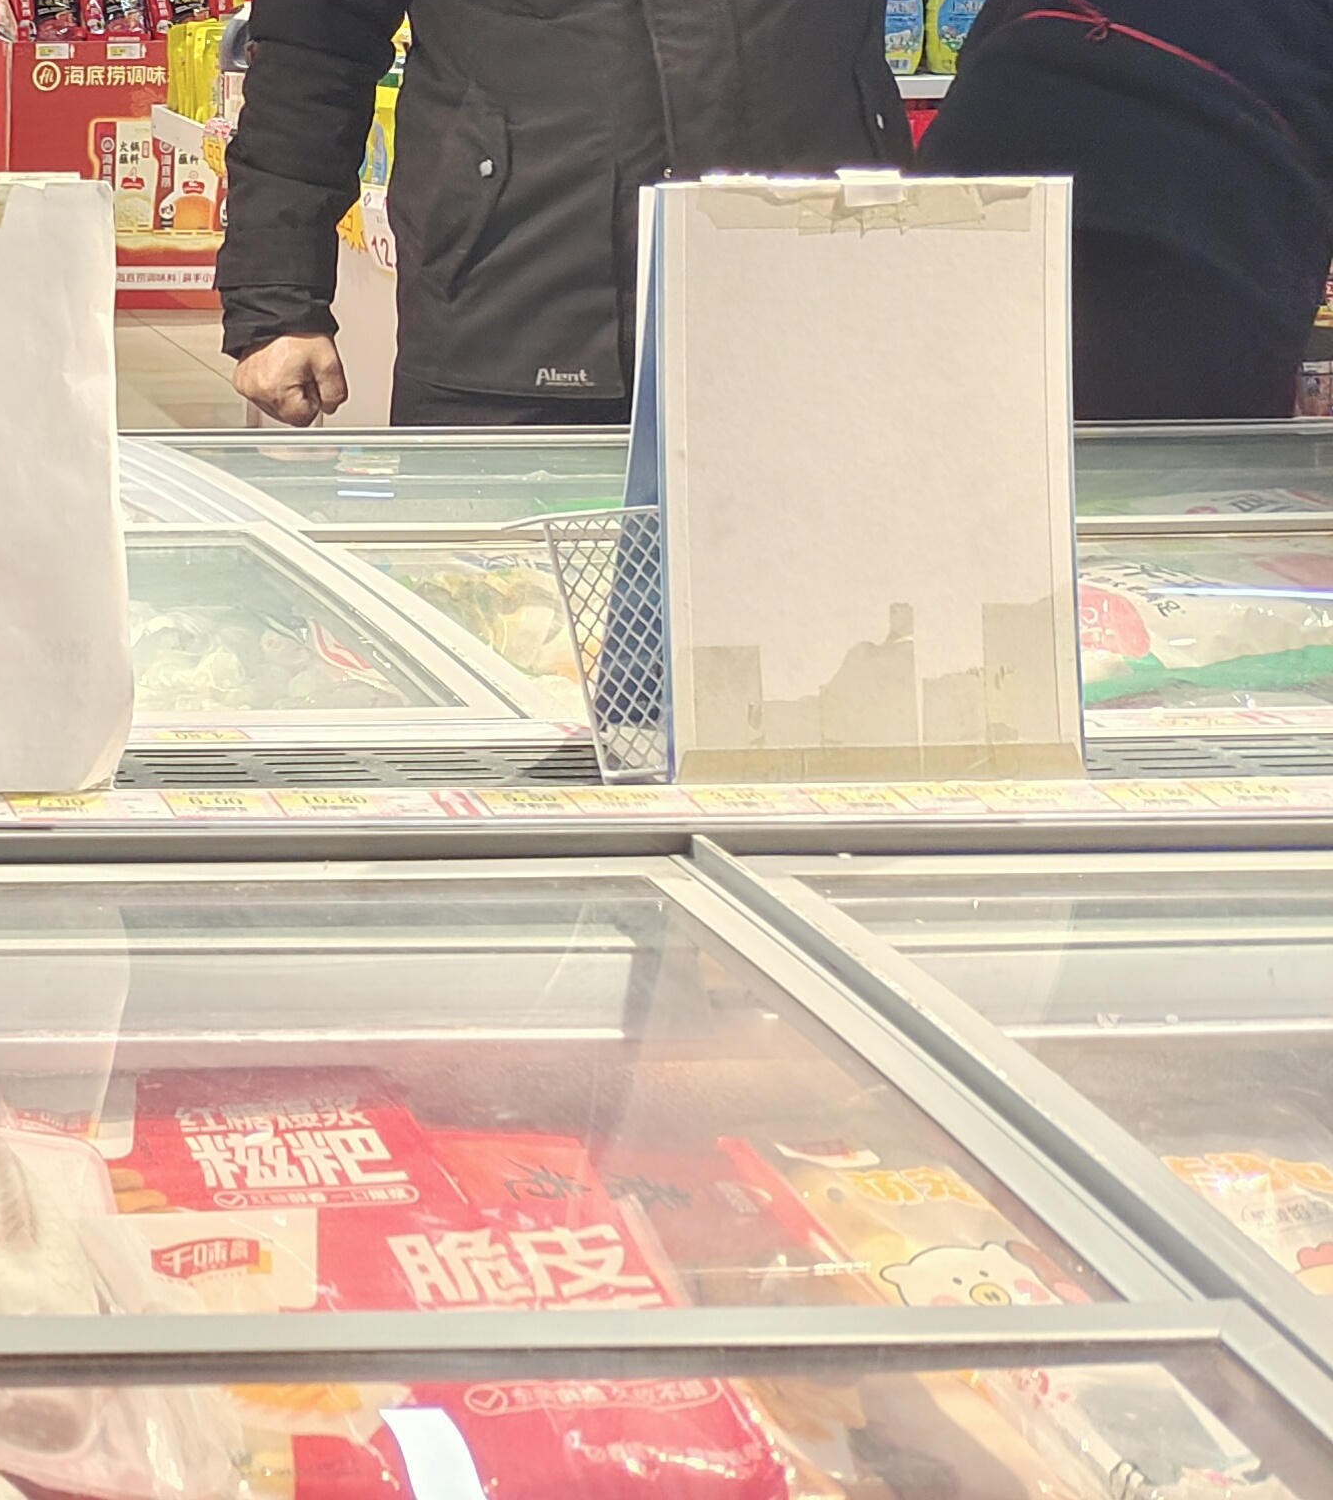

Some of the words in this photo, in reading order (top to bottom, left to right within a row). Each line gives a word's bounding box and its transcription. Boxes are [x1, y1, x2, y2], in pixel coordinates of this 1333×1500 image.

[64, 66, 170, 87] 海底捞调味
[184, 1126, 412, 1190] 糍粑
[387, 1224, 656, 1304] 脆皮
